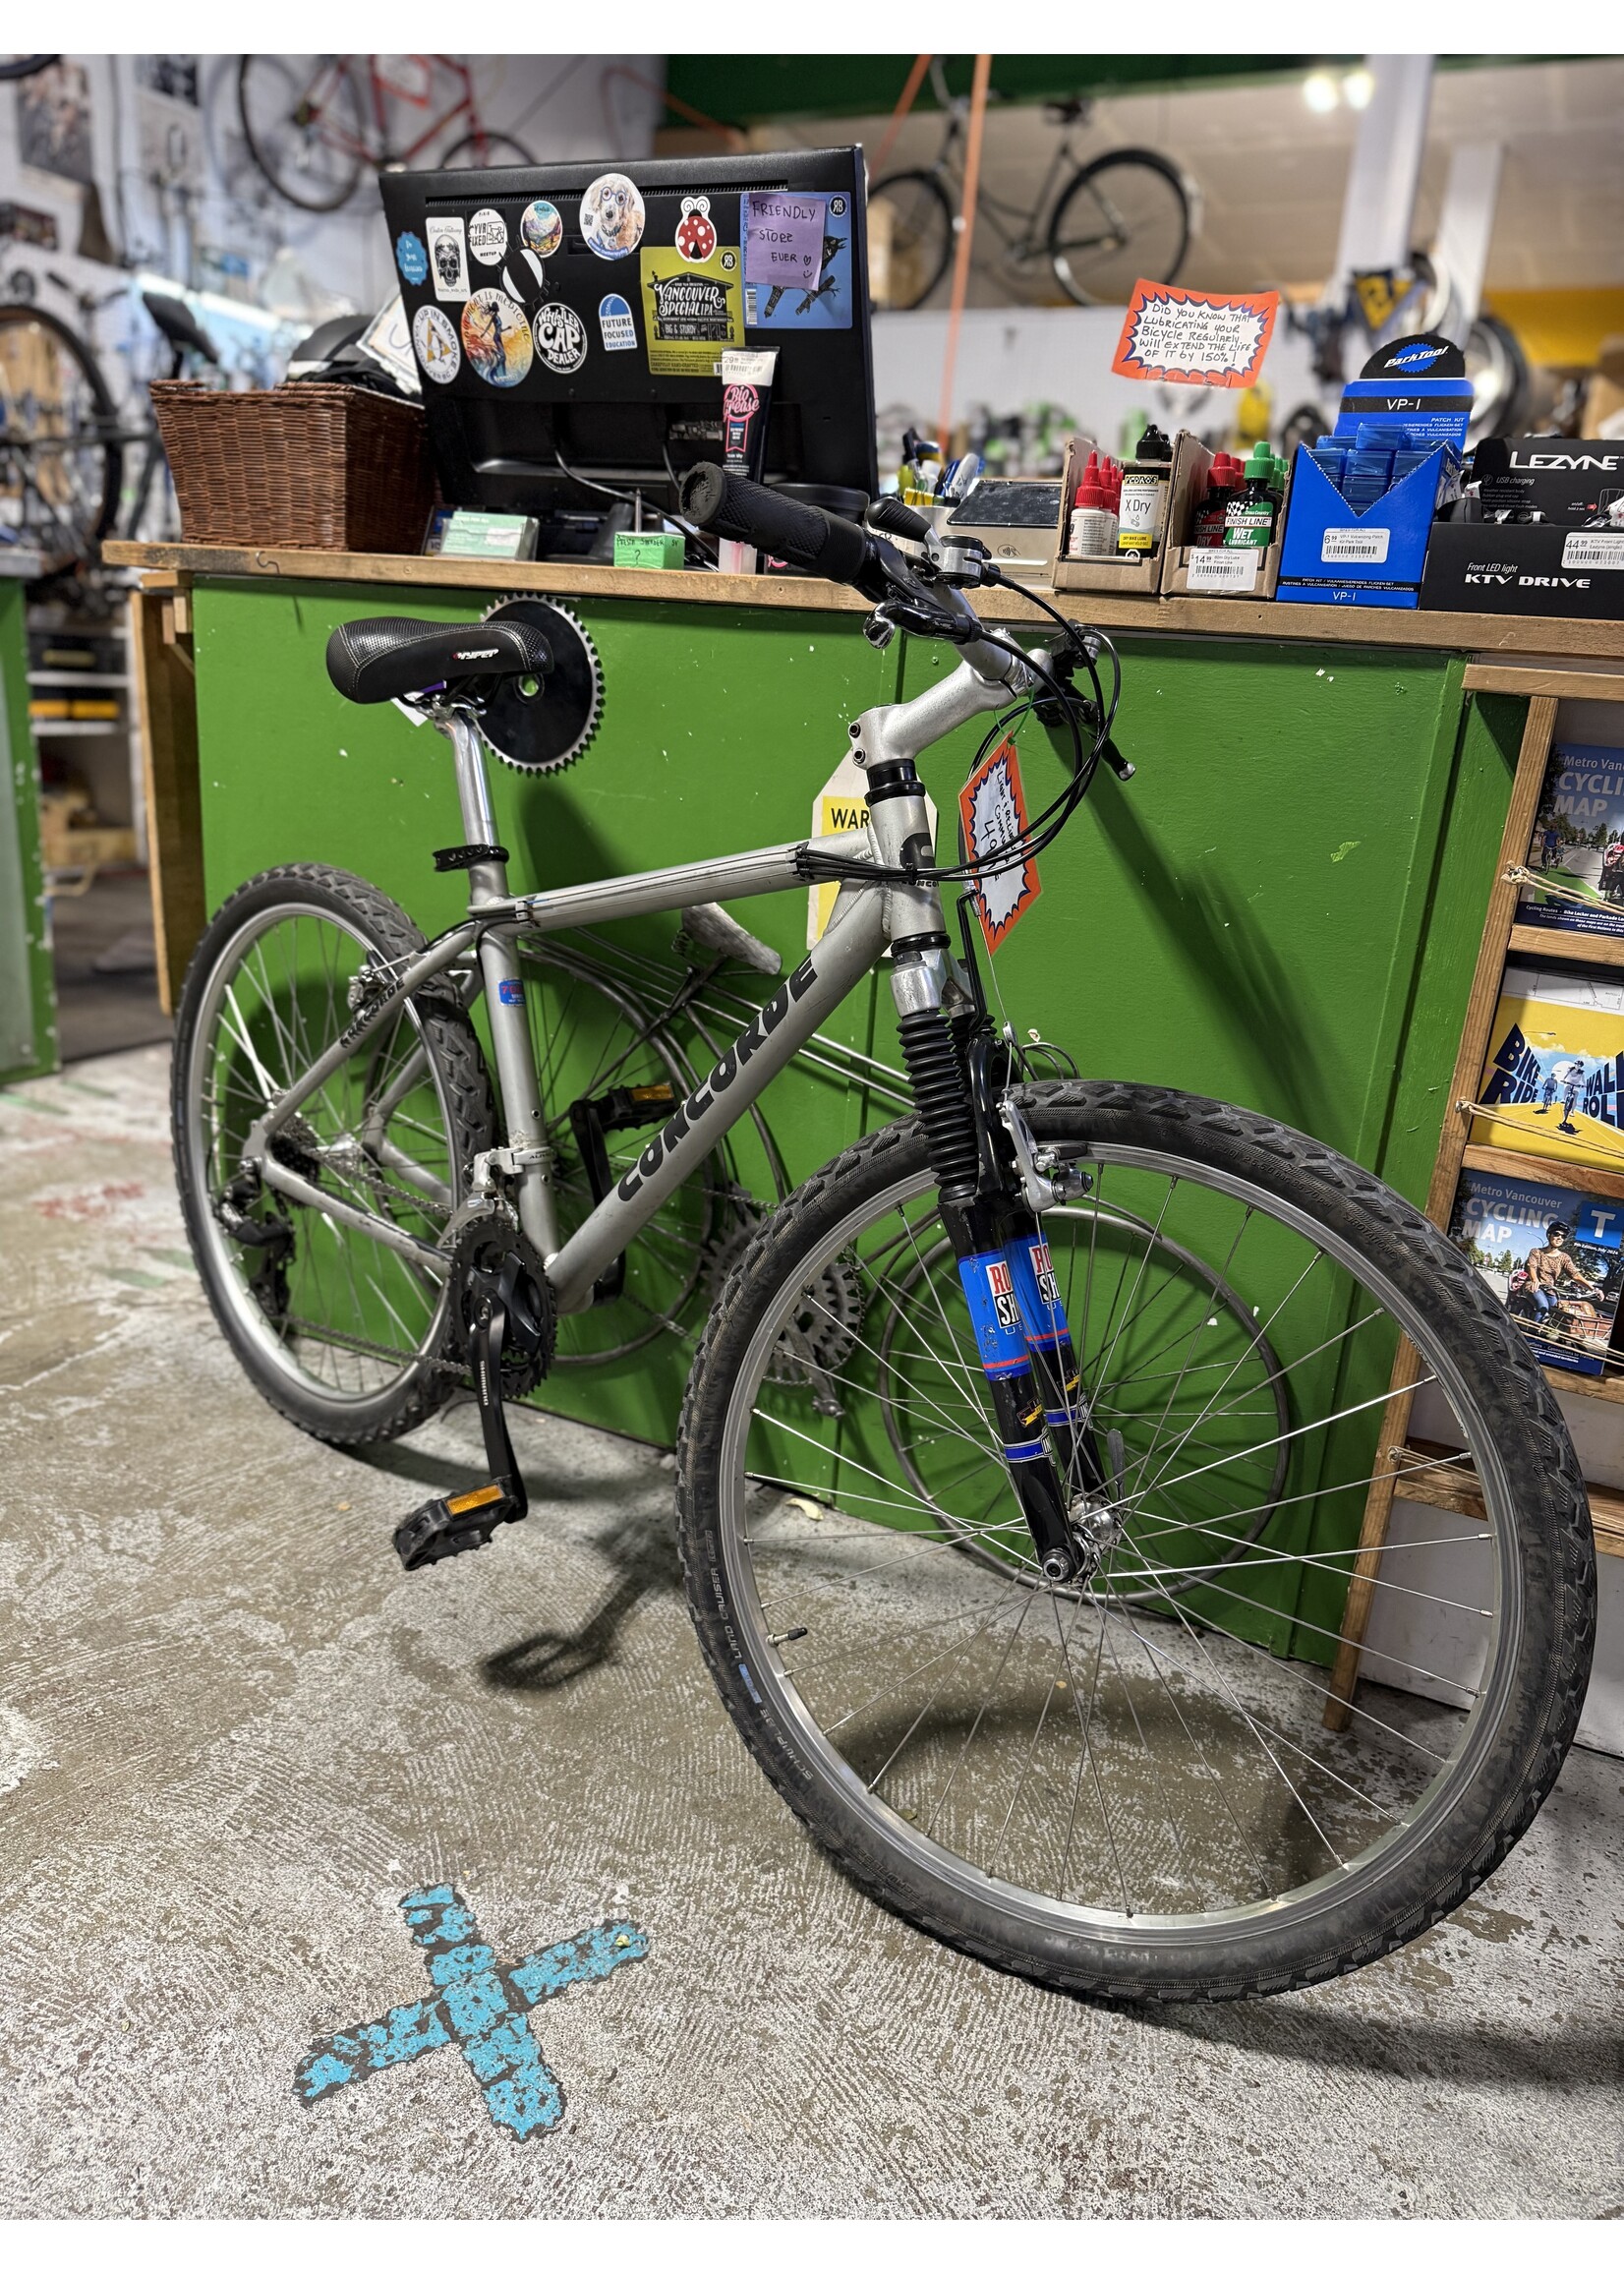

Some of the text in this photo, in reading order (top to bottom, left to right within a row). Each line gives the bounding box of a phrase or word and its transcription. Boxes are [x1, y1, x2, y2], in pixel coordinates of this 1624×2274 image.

[752, 201, 816, 221] FRIENDLY
[654, 278, 725, 309] VANCOUVER
[659, 301, 700, 316] SPECIAL
[1197, 310, 1226, 321] KNOW
[539, 306, 581, 333] WHISTLER
[602, 318, 632, 328] FUTURE
[419, 309, 459, 370] UP IN SMOKE
[538, 321, 581, 353] CAP
[604, 330, 634, 339] FOCUSED
[606, 339, 636, 348] EDUCATION
[547, 348, 581, 365] DEALER
[1144, 349, 1159, 358] OF
[1509, 451, 1619, 471] LEZYNE
[1510, 477, 1535, 486] charging
[1126, 499, 1152, 514] X Dry
[1233, 528, 1254, 540] WET
[1566, 540, 1579, 549] 44
[1468, 562, 1518, 574] Front LED light
[1465, 574, 1592, 589] KTV DRIVE
[1564, 755, 1624, 771] Metro Van
[1553, 794, 1608, 817] MAP
[1493, 1022, 1541, 1087] BIKE
[617, 951, 819, 1202] CONCORDE
[1479, 1067, 1539, 1105] RIDE
[1471, 1183, 1562, 1208] Metro Vancouver
[1466, 1197, 1559, 1230] CYCLING
[1462, 1219, 1512, 1244] MAP
[1591, 1209, 1616, 1239] T
[711, 1567, 729, 1621] CRUISER
[724, 1625, 742, 1660] LAND
